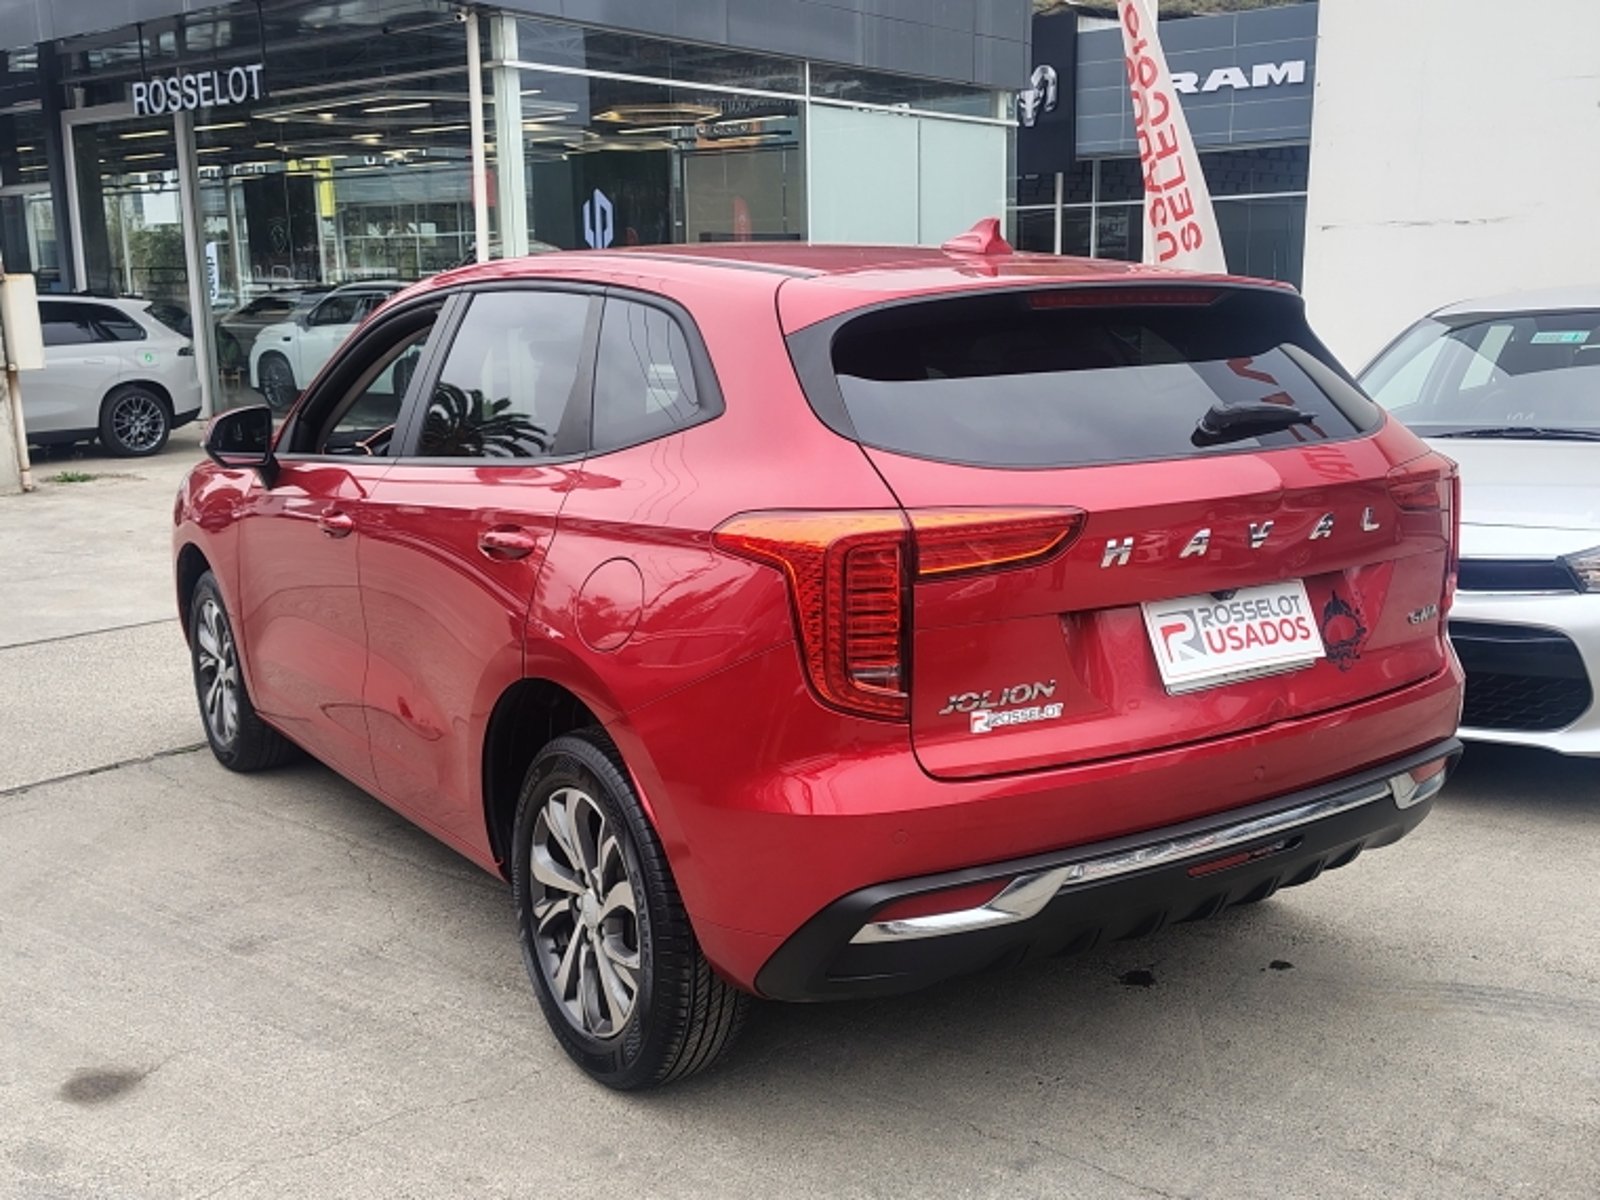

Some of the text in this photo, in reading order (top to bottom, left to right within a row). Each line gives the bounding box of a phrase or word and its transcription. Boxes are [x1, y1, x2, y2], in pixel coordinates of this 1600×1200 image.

[131, 64, 263, 115] ROSSELOT
[1170, 60, 1306, 94] RAM
[1100, 506, 1380, 568] HAVAL
[1199, 595, 1301, 629] ROSSELOT
[1203, 615, 1312, 655] USADOS
[938, 679, 1057, 715] JOLION
